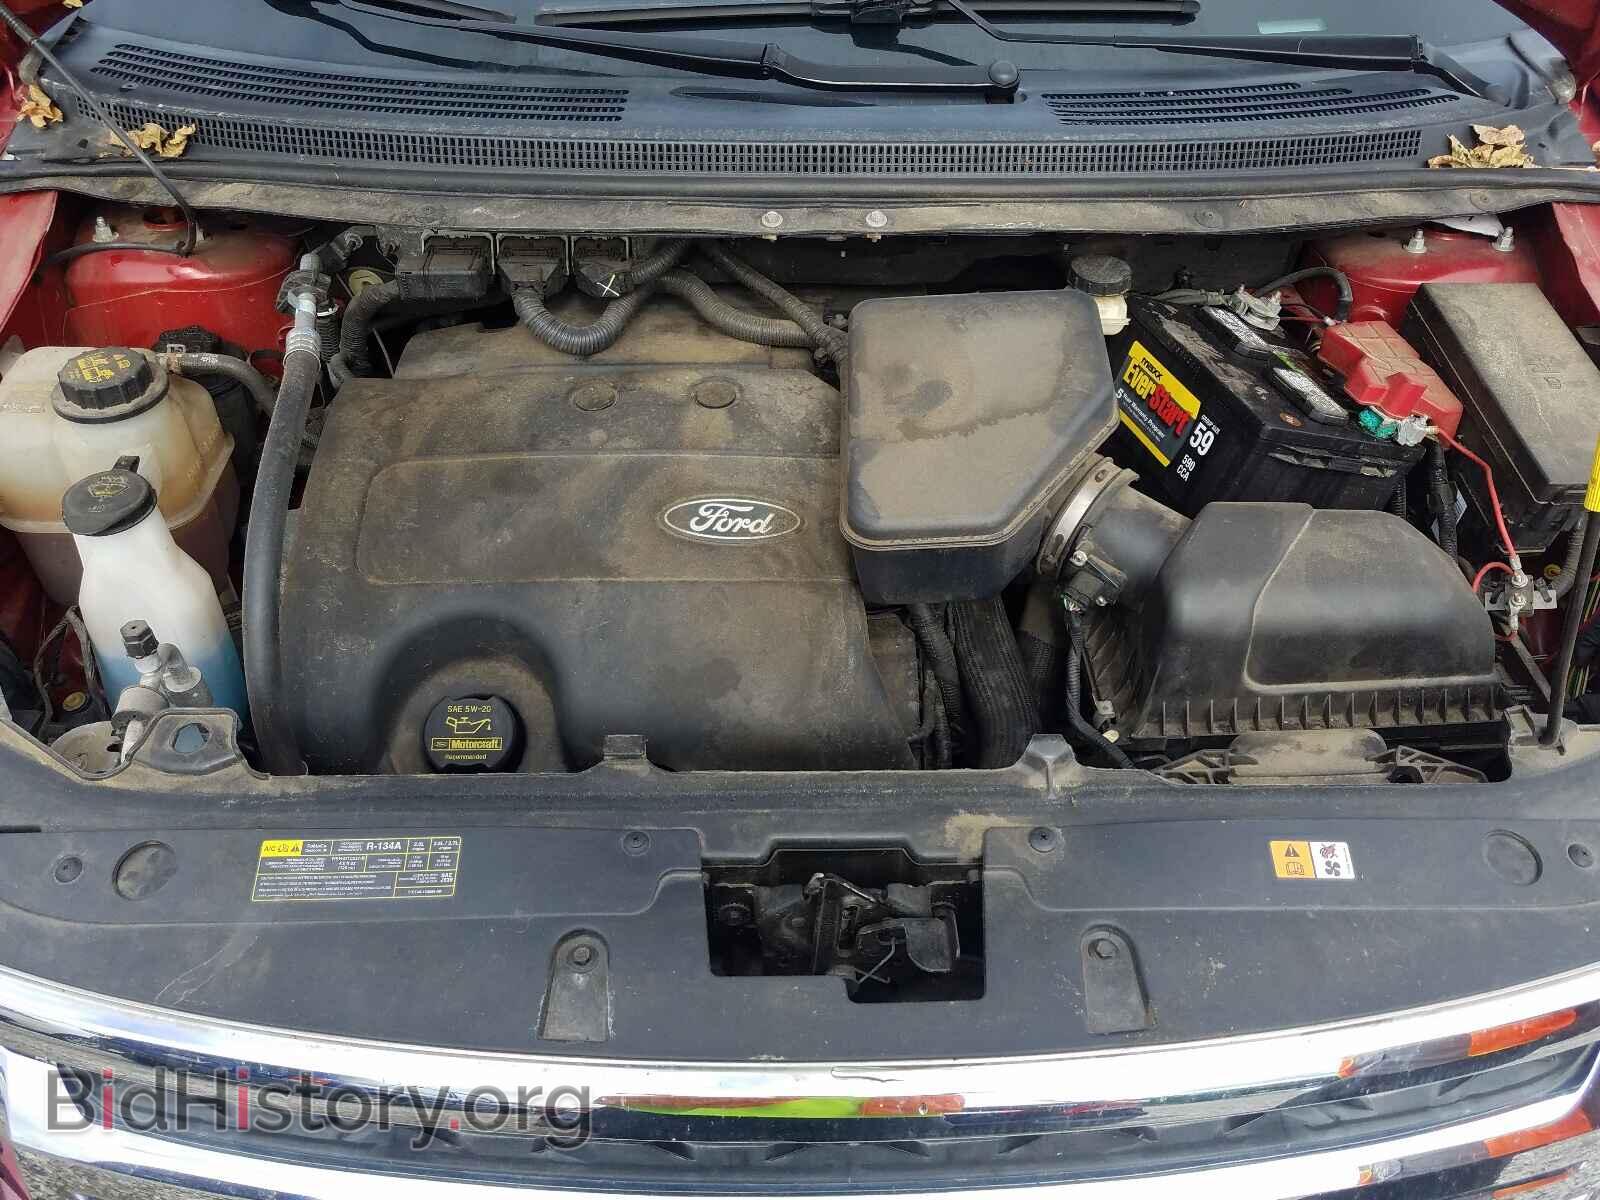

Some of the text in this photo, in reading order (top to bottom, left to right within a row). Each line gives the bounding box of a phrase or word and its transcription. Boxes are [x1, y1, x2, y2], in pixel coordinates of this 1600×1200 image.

[1115, 388, 1125, 399] 5
[1190, 421, 1215, 456] 59
[1182, 454, 1196, 472] 590
[1177, 464, 1190, 482] CCA
[690, 503, 775, 533] Ford
[447, 705, 492, 713] SAE 5W-20
[451, 739, 499, 750] Motorcraft
[366, 841, 402, 851] R-134A
